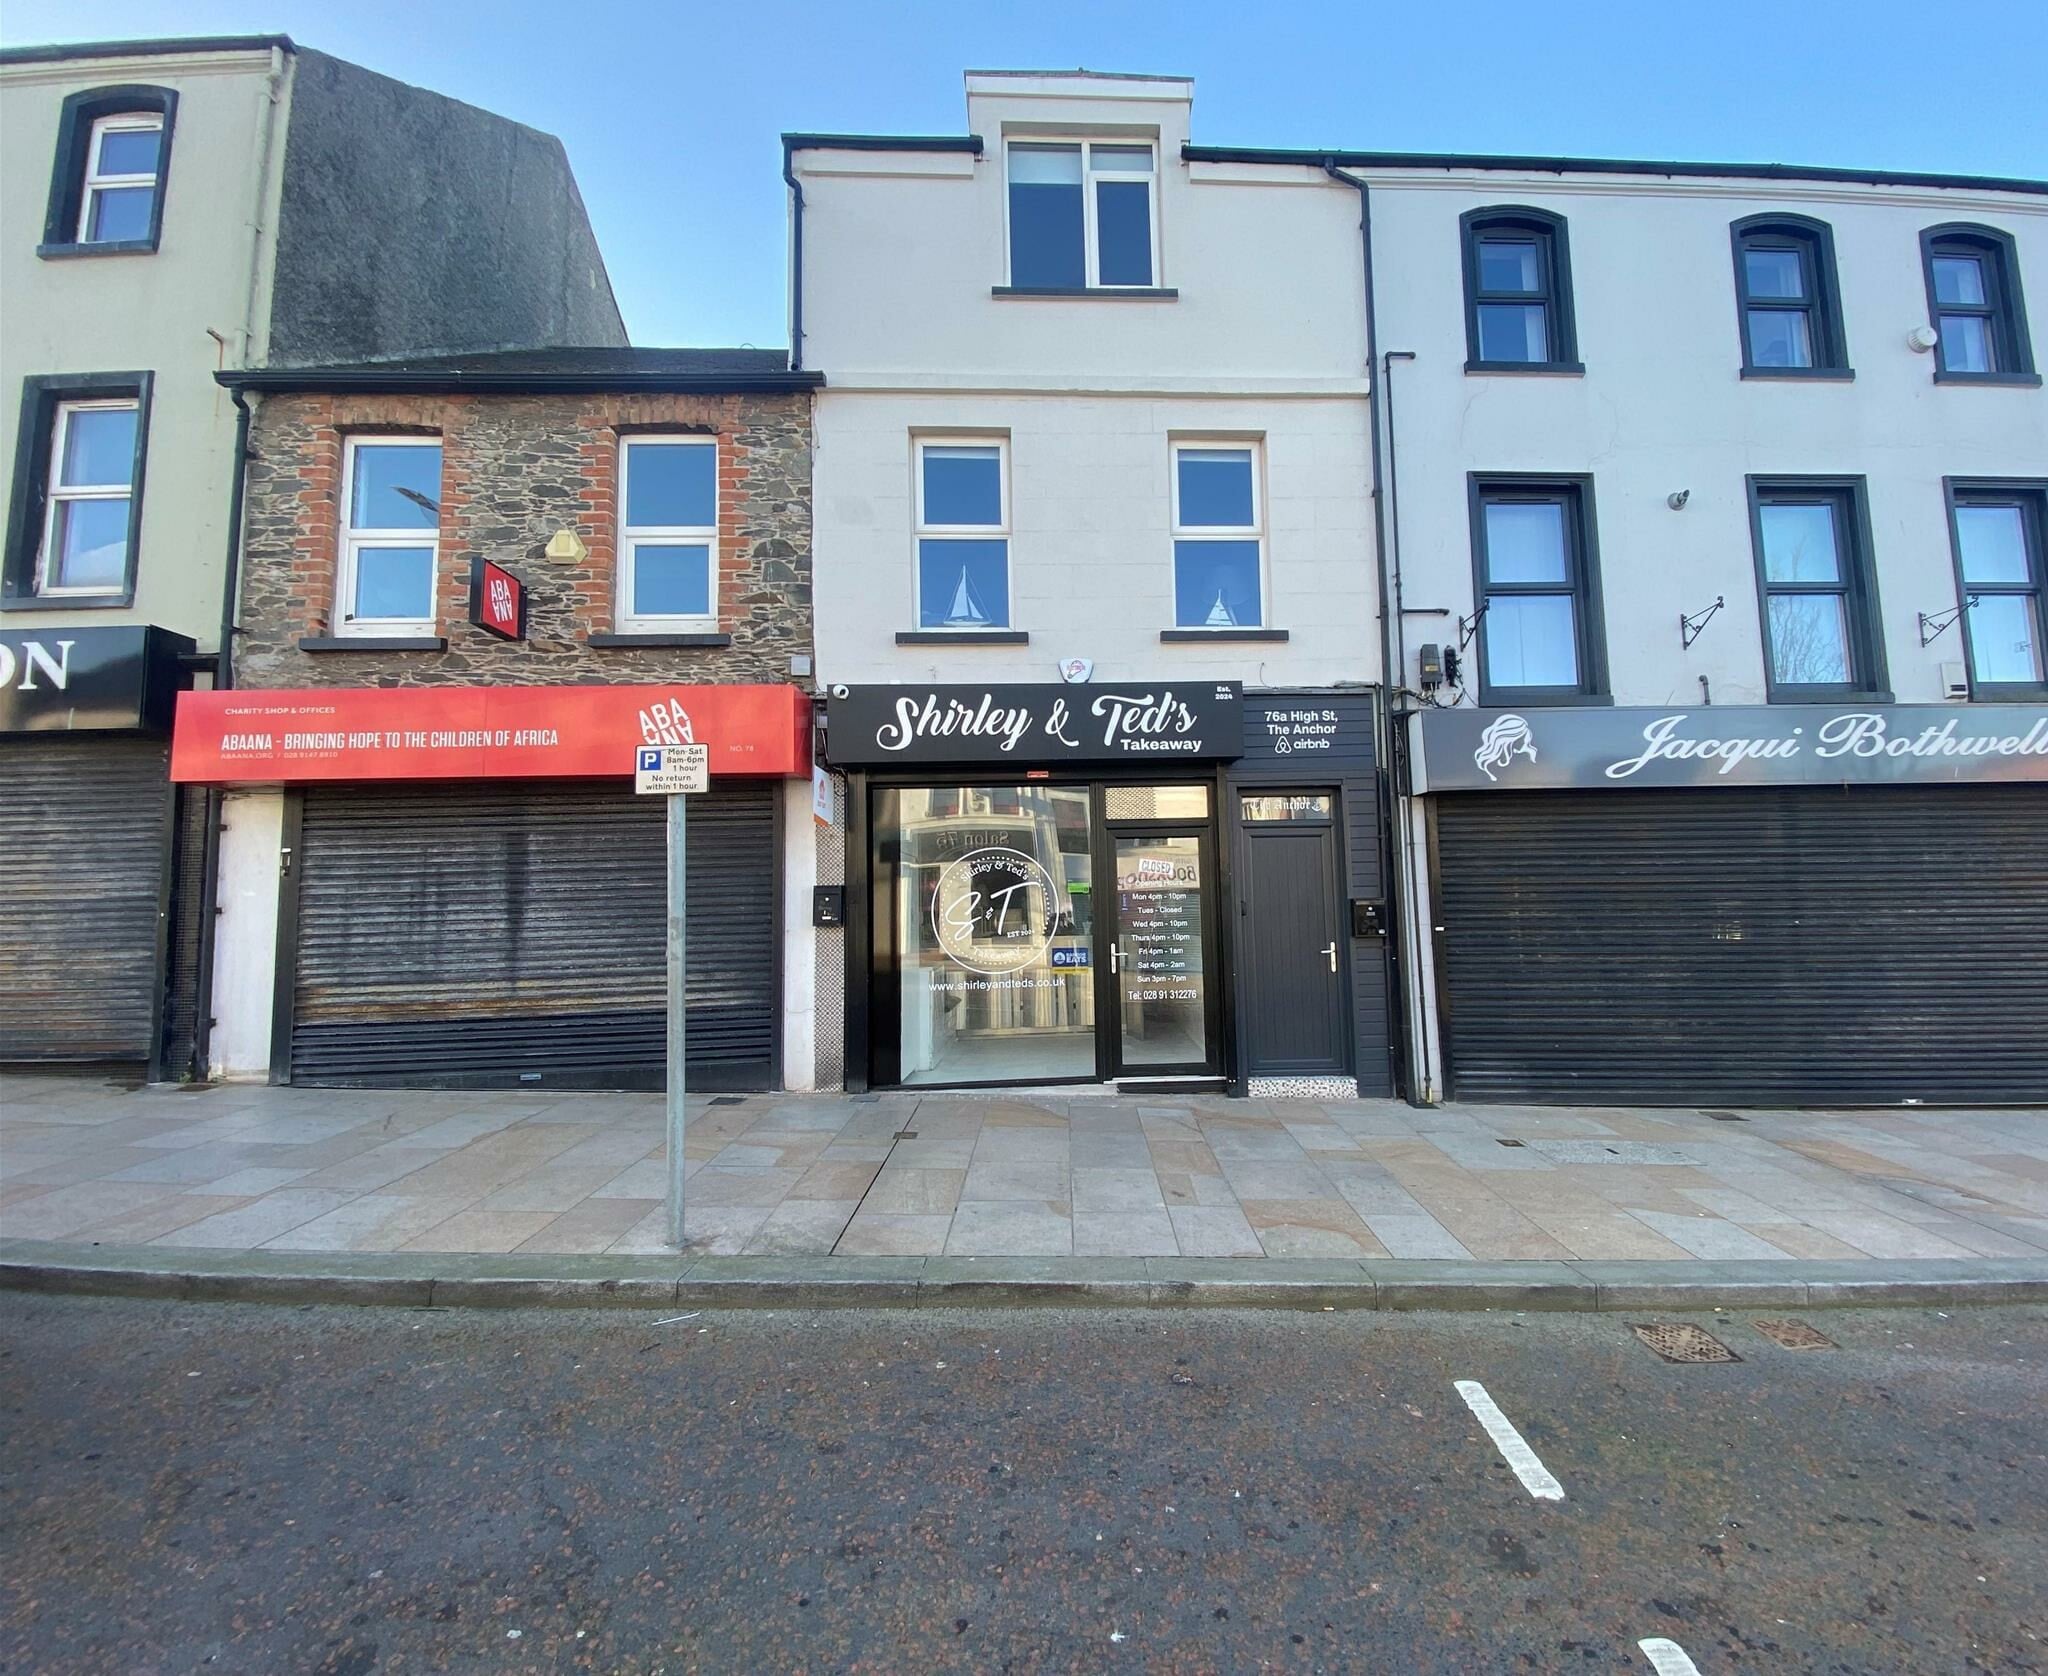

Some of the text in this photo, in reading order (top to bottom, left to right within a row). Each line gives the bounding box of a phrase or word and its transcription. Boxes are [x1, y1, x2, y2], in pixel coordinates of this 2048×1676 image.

[490, 579, 512, 602] ABA
[299, 706, 336, 714] OFFICES
[1264, 710, 1338, 724] 76a High St,
[639, 698, 690, 737] ABA
[876, 691, 1198, 752] Shirley & Ted's
[1267, 723, 1337, 735] The Anchor
[221, 733, 273, 751] ABAANA
[284, 732, 345, 750] BRINGING
[348, 732, 381, 749] HOPE
[384, 731, 401, 748] TO
[404, 731, 427, 748] THE
[430, 730, 492, 747] CHILDREN
[495, 730, 511, 746] OF
[513, 729, 559, 746] AFRICA
[1120, 738, 1202, 752] Takeaway
[1293, 738, 1330, 749] airbnb
[1604, 714, 1802, 778] Jacqui
[644, 753, 657, 768] P
[960, 860, 1029, 880] Shirley & Ted's
[1141, 860, 1171, 874] CLOSED
[1148, 893, 1163, 902] 4pm
[1168, 892, 1187, 901] 10pm
[1149, 921, 1164, 929] 4pm
[1169, 920, 1188, 929] 10pm
[1152, 934, 1166, 942] 4pm
[1172, 933, 1190, 942] 10pm
[1149, 948, 1164, 956] 4pm
[1150, 962, 1165, 970] 4pm
[928, 978, 1066, 992] www.shirleyandteds.co.uk
[1172, 975, 1187, 983] 7pm
[1128, 990, 1197, 1000] Tel: 028 91 312276
